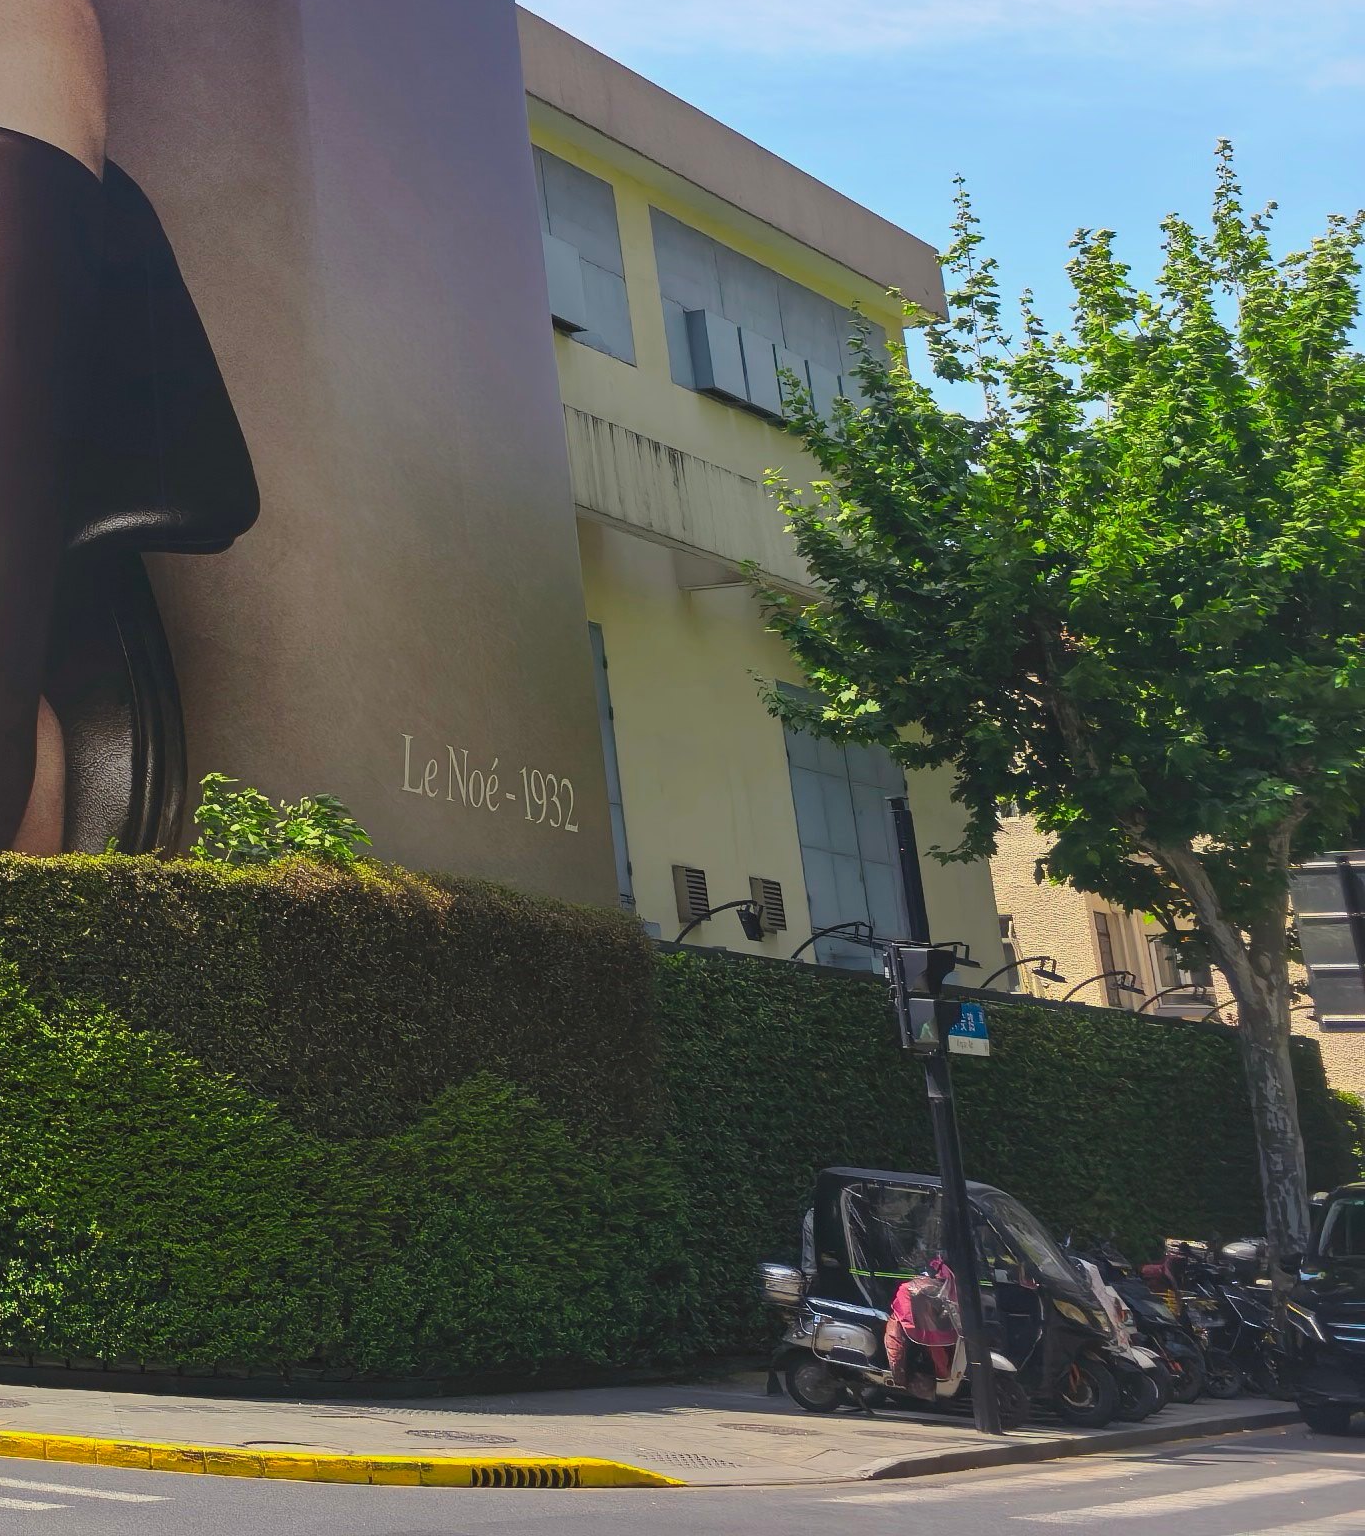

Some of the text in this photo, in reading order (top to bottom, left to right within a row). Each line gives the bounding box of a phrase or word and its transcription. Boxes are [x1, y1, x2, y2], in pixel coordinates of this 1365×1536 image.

[399, 733, 439, 798] Le
[446, 744, 500, 812] Noé
[519, 766, 578, 832] 1932
